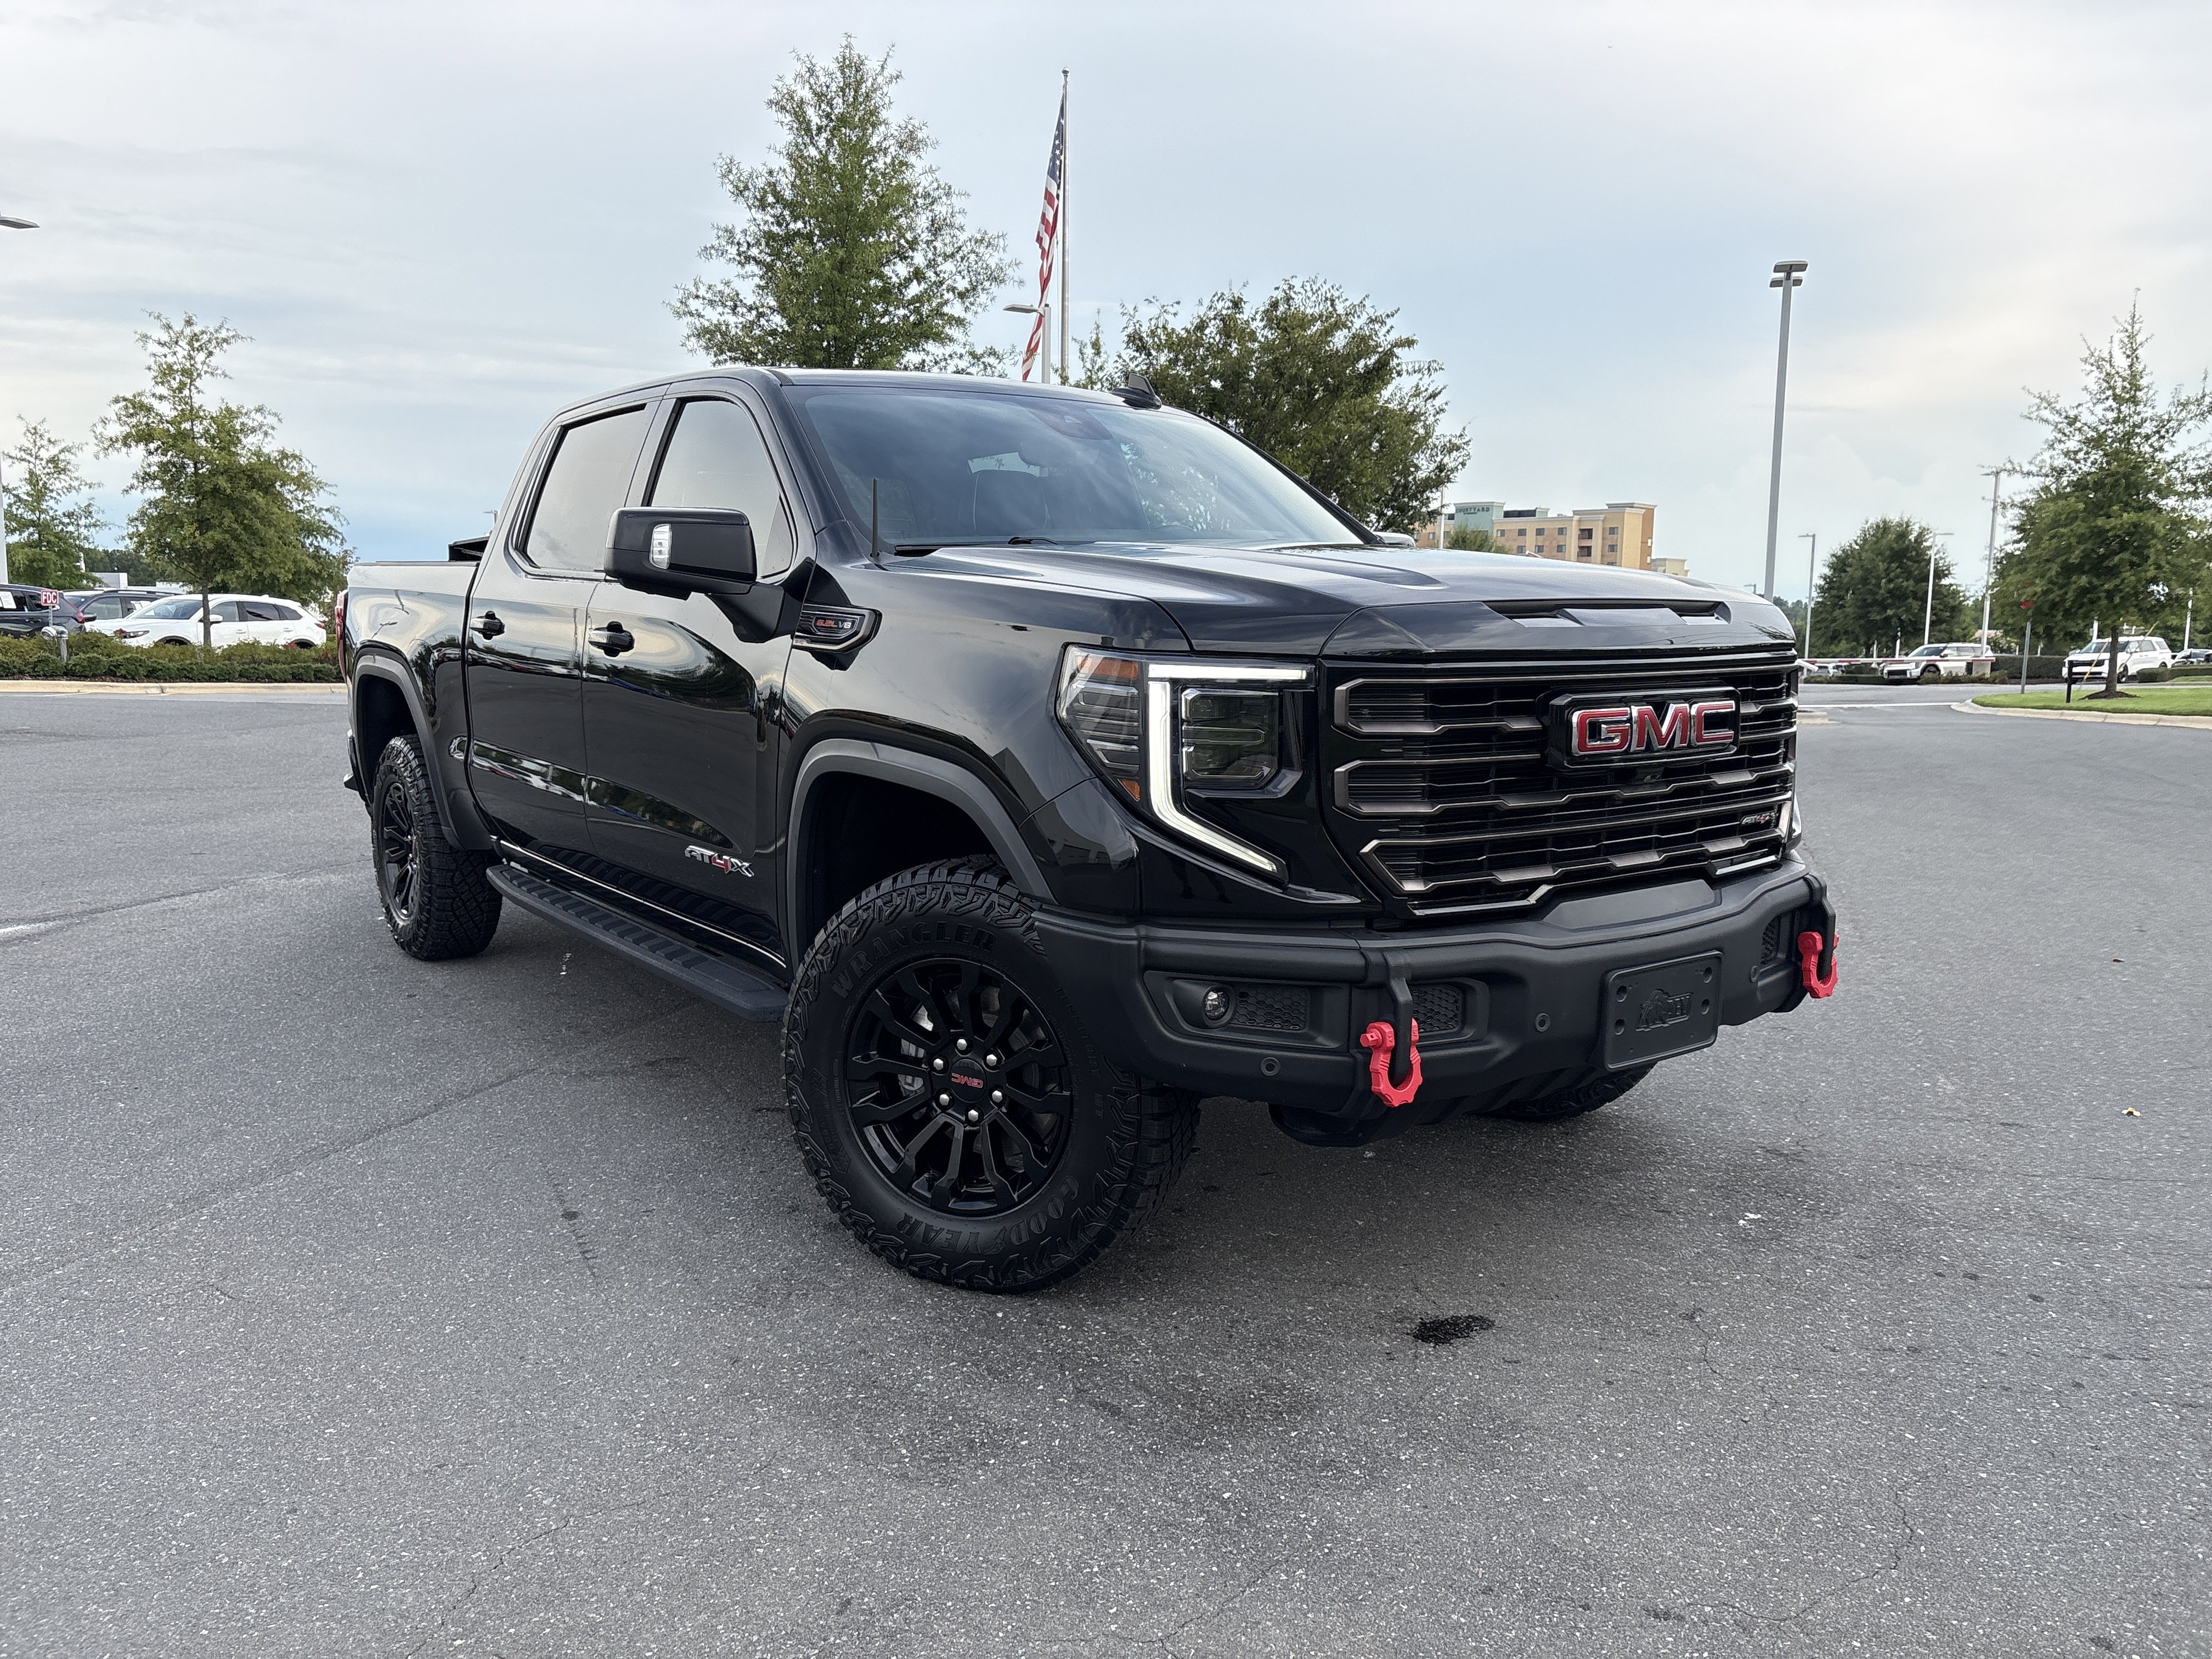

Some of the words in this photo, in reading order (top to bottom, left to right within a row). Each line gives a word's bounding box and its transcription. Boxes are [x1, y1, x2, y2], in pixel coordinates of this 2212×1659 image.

[42, 591, 57, 603] FDC
[816, 619, 838, 628] 6.2L
[1572, 700, 1735, 757] GMC
[684, 845, 755, 877] AT4X
[831, 921, 996, 999] WRANGLER
[951, 1072, 984, 1088] GMC
